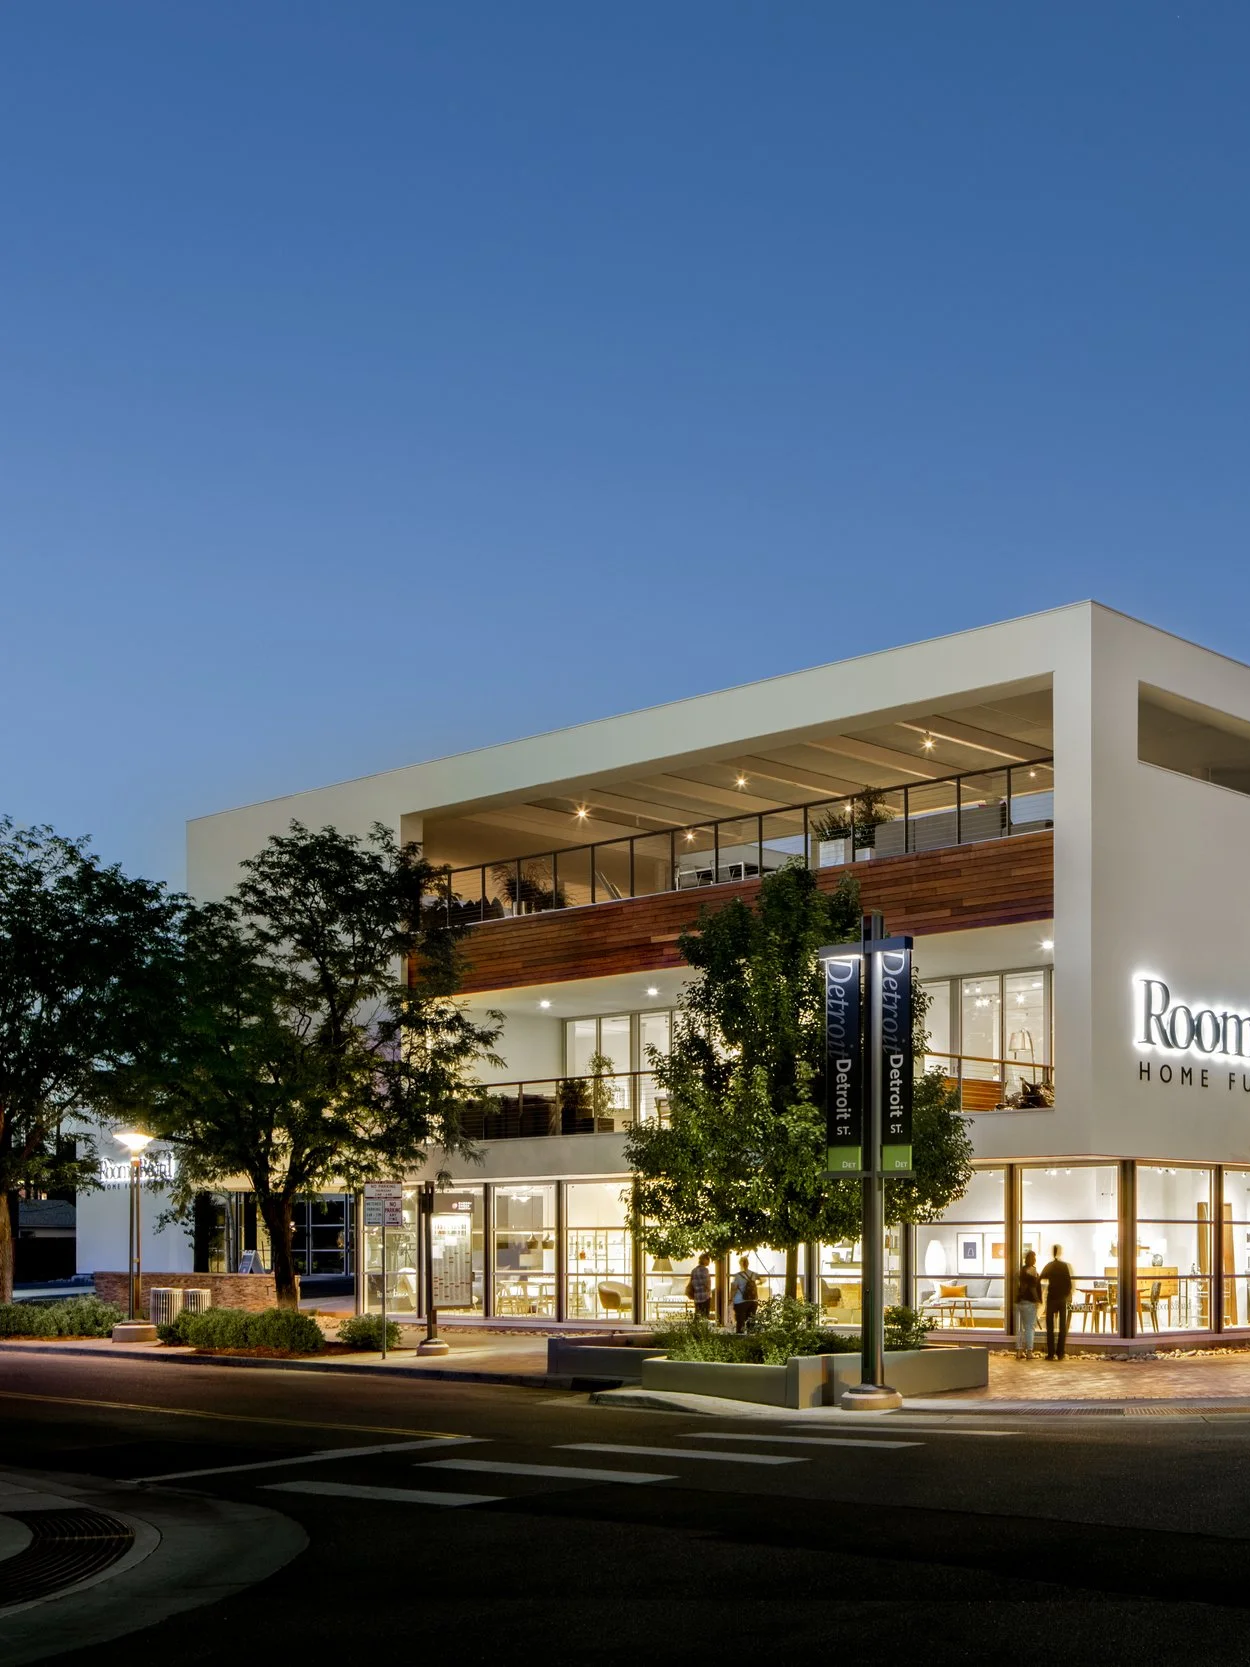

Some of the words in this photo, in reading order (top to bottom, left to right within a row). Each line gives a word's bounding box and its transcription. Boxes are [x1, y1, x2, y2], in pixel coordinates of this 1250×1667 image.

[827, 959, 853, 1062] Detroit
[882, 951, 905, 1055] Detroit
[836, 1059, 852, 1120] Detroit
[889, 1054, 904, 1118] Detroit
[1139, 1061, 1208, 1088] HOME
[836, 1126, 852, 1136] ST.
[890, 1124, 904, 1134] ST.
